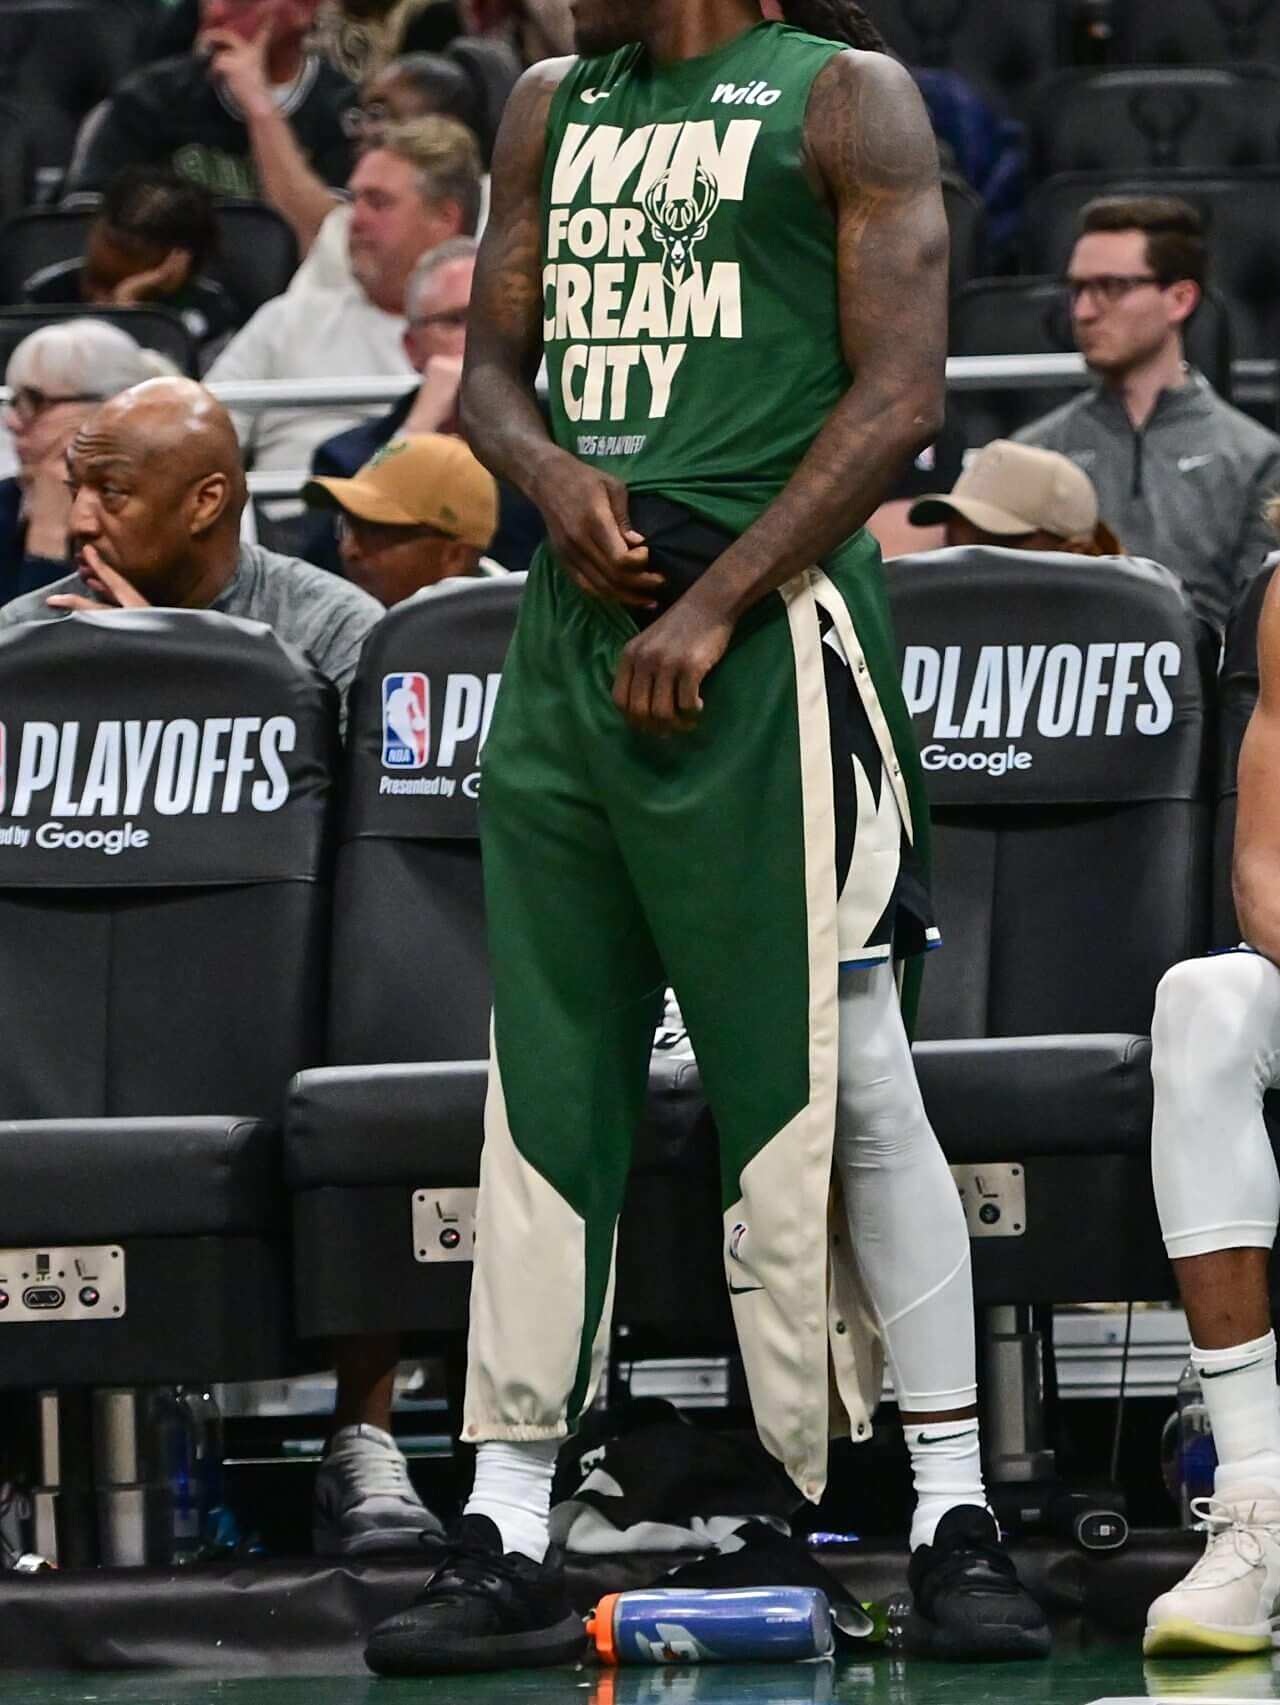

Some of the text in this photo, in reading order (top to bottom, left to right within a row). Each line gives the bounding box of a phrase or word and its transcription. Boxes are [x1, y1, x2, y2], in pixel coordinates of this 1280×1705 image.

[551, 119, 762, 204] WIN
[547, 207, 646, 259] FOR
[542, 262, 743, 341] CREAM
[561, 343, 687, 422] CITY
[901, 640, 1182, 739] PLAYOFFS
[11, 715, 297, 817] PLAYOFFS
[379, 775, 440, 795] Presented
[441, 776, 456, 798] by
[919, 744, 1033, 777] Google
[35, 821, 150, 855] Google
